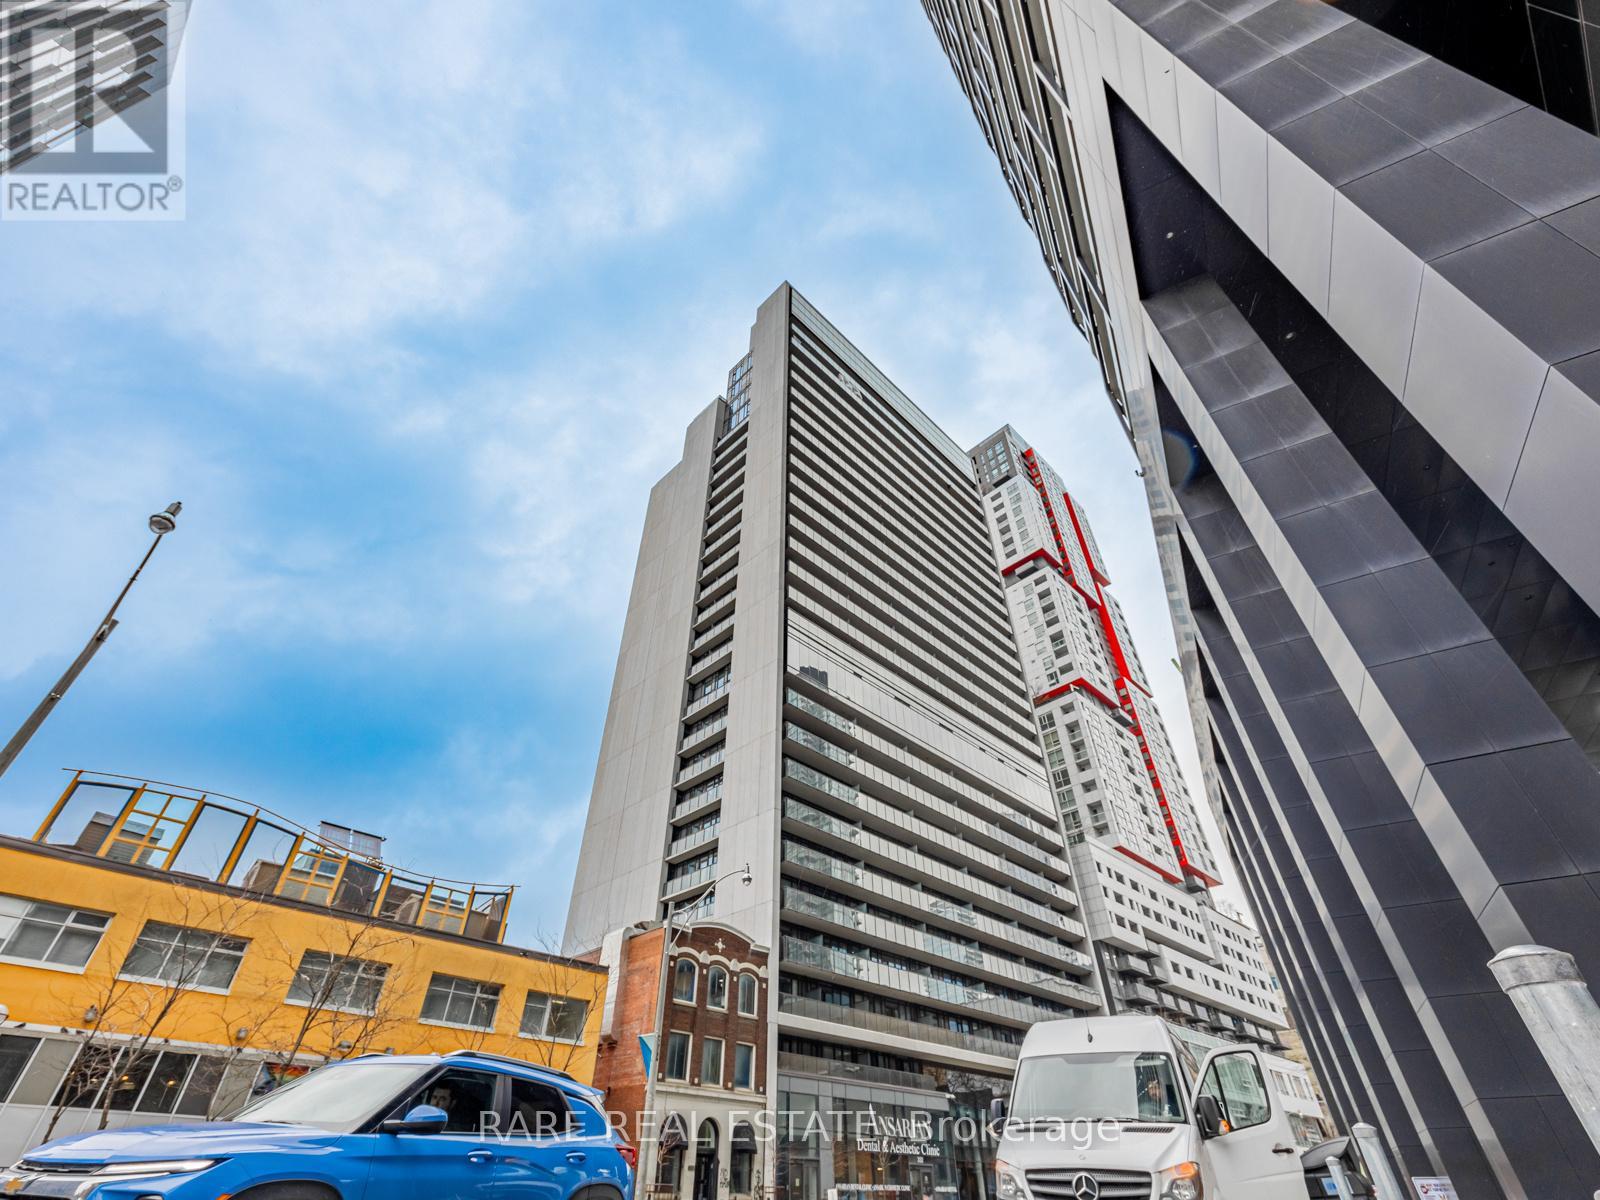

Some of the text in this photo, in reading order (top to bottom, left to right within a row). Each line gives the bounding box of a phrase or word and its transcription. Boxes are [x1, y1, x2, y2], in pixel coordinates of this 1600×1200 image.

[857, 1138, 880, 1152] Dental
[890, 1141, 920, 1156] Aesthetic
[920, 1143, 940, 1156] Clinic
